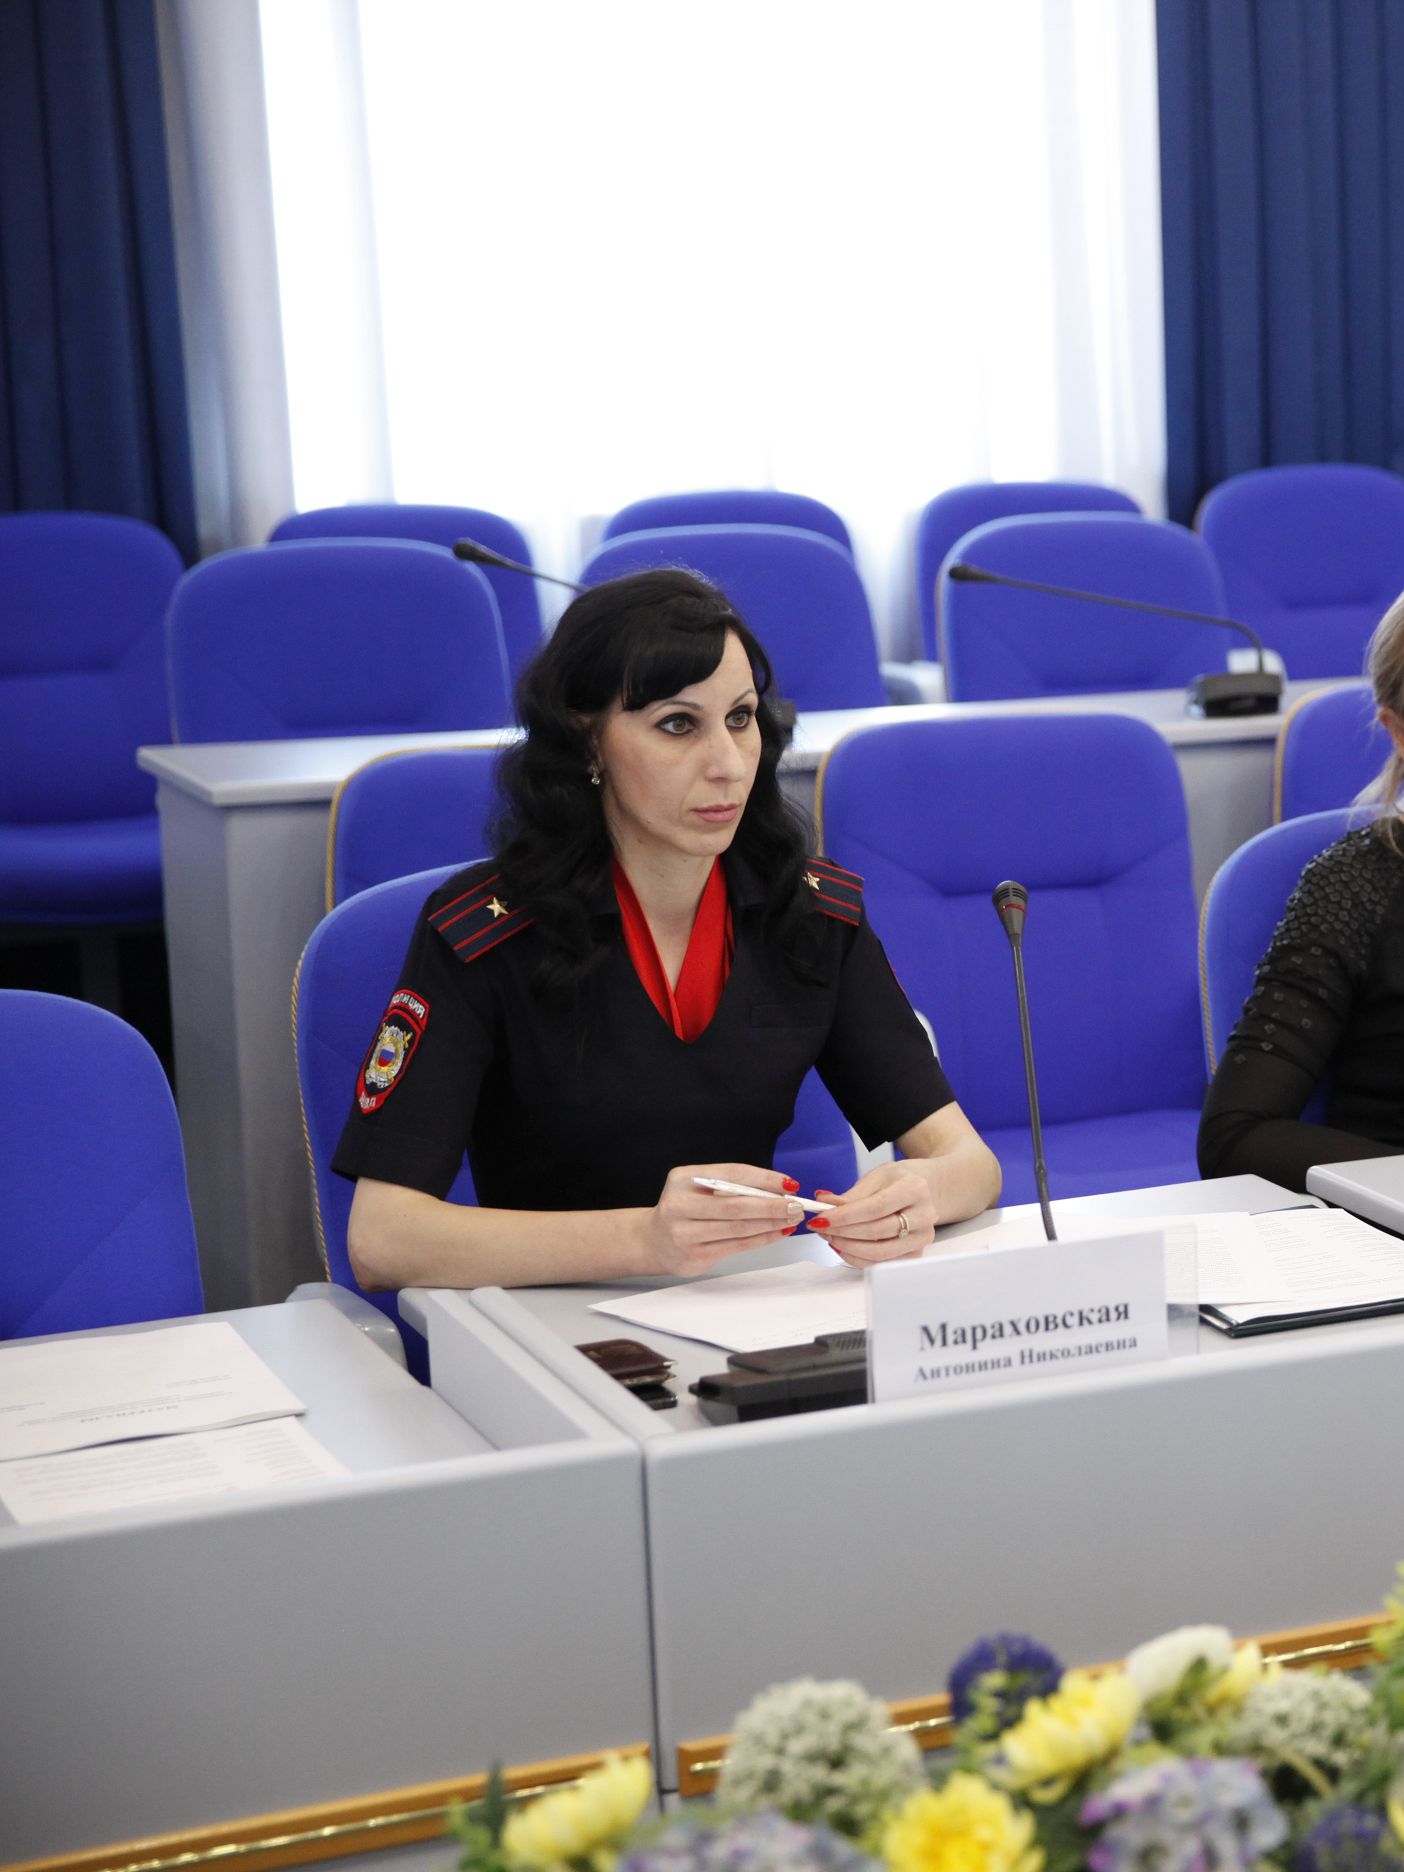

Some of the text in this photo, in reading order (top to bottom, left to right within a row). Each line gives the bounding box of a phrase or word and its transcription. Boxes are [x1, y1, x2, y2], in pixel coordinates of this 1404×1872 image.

[919, 1302, 1131, 1352] Мараховская
[913, 1336, 1138, 1384] Антонина Николаевна
